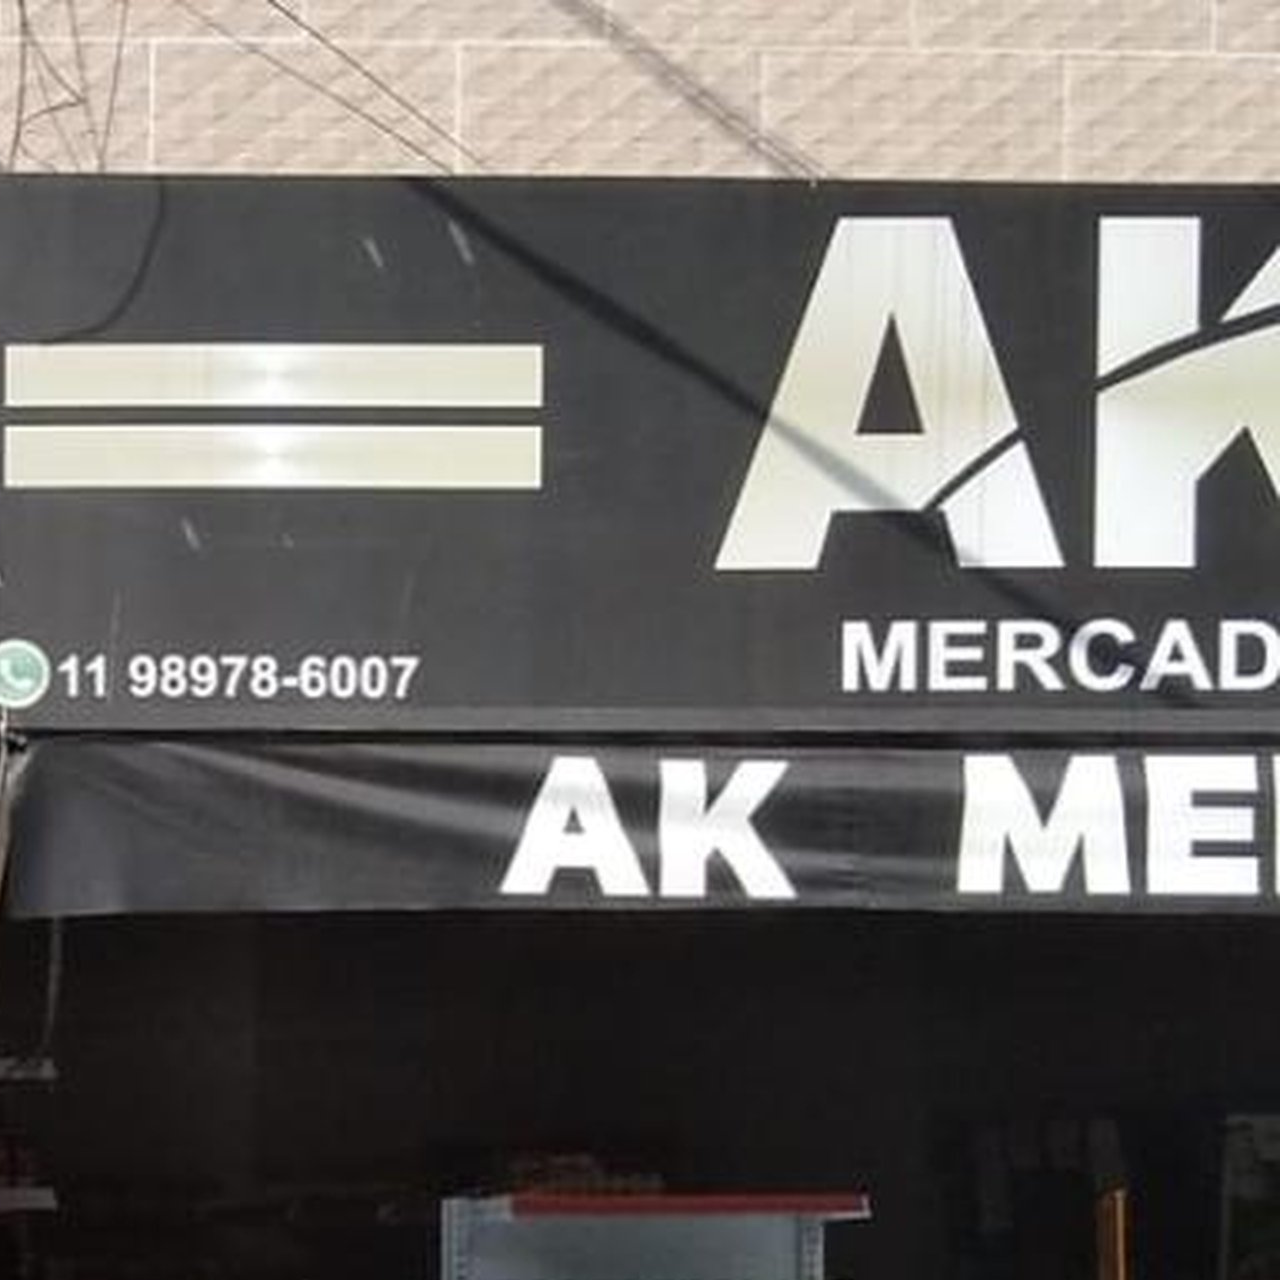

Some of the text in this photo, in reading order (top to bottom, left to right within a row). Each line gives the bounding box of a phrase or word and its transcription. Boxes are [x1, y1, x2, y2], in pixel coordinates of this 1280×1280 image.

[714, 216, 1280, 570] AK
[58, 654, 420, 699] 11 98978-6007
[841, 618, 1280, 692] MERCAD
[500, 753, 1280, 899] AK ME
